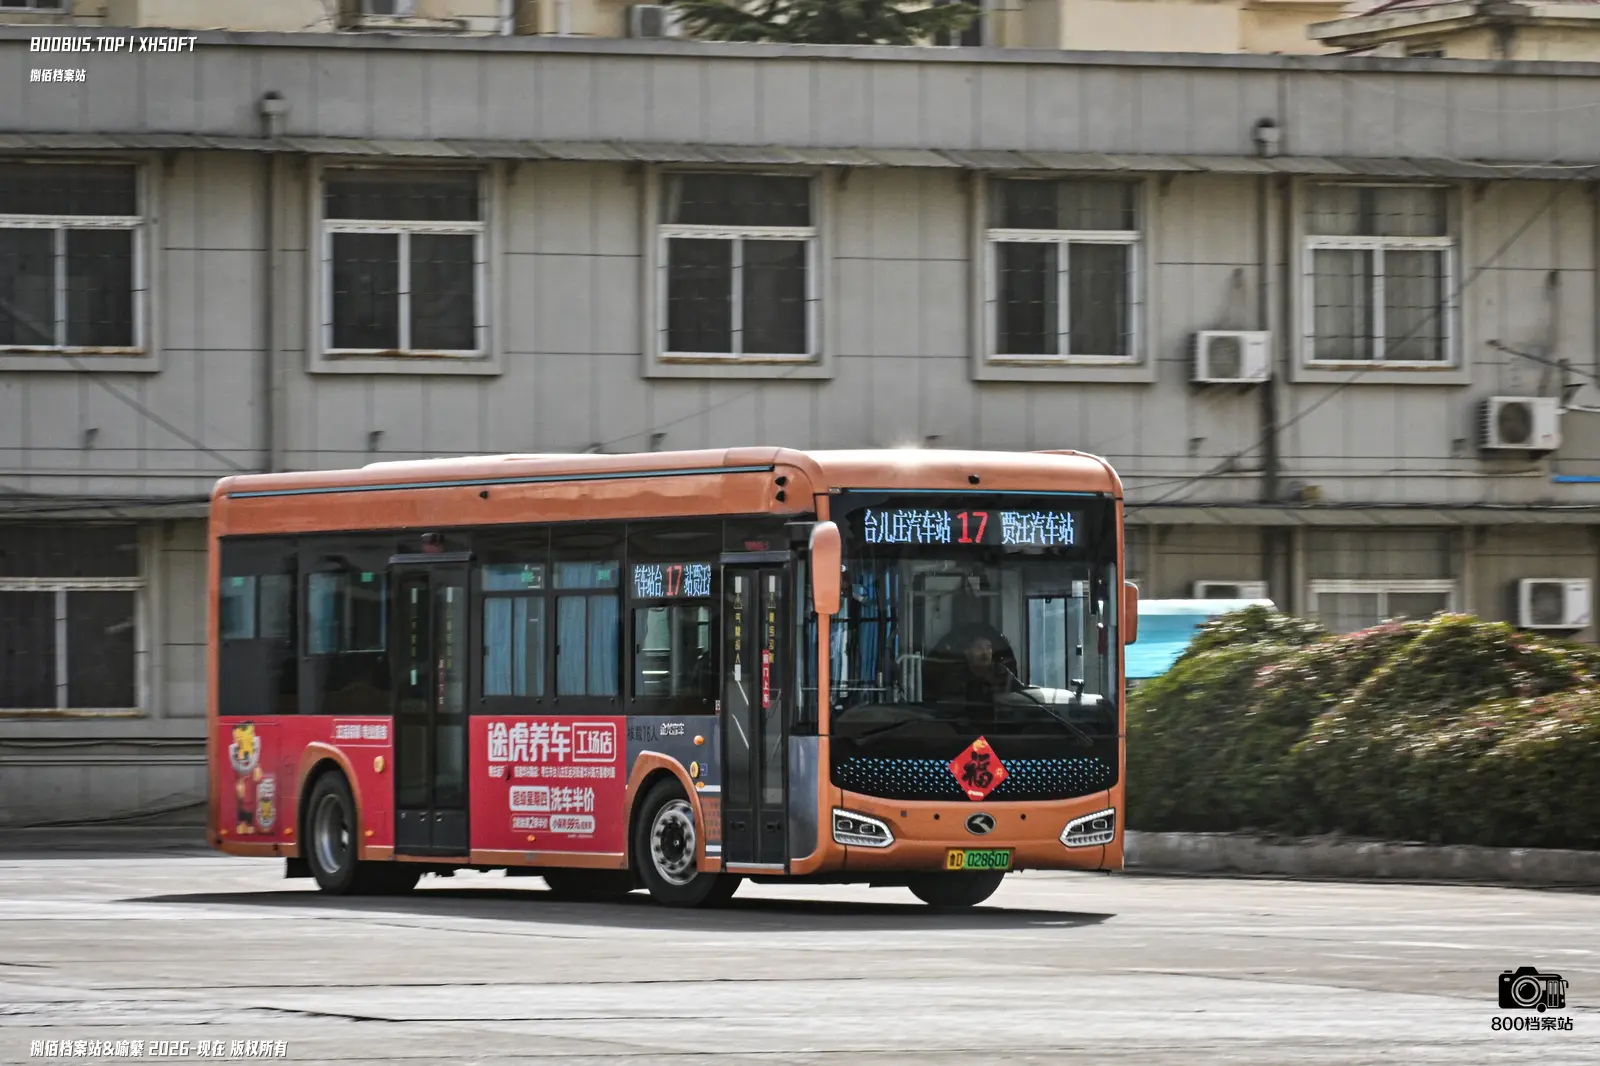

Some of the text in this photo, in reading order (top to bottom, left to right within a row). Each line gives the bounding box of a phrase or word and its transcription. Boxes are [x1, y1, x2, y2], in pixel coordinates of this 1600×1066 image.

[864, 509, 1074, 544] 台儿庄汽车站 17 贾汪汽车站
[666, 565, 682, 596] 17
[488, 722, 612, 762] 途虎养车 工场店
[962, 751, 993, 788] 福
[550, 786, 595, 812] 洗车半价
[967, 852, 1009, 868] 02860D
